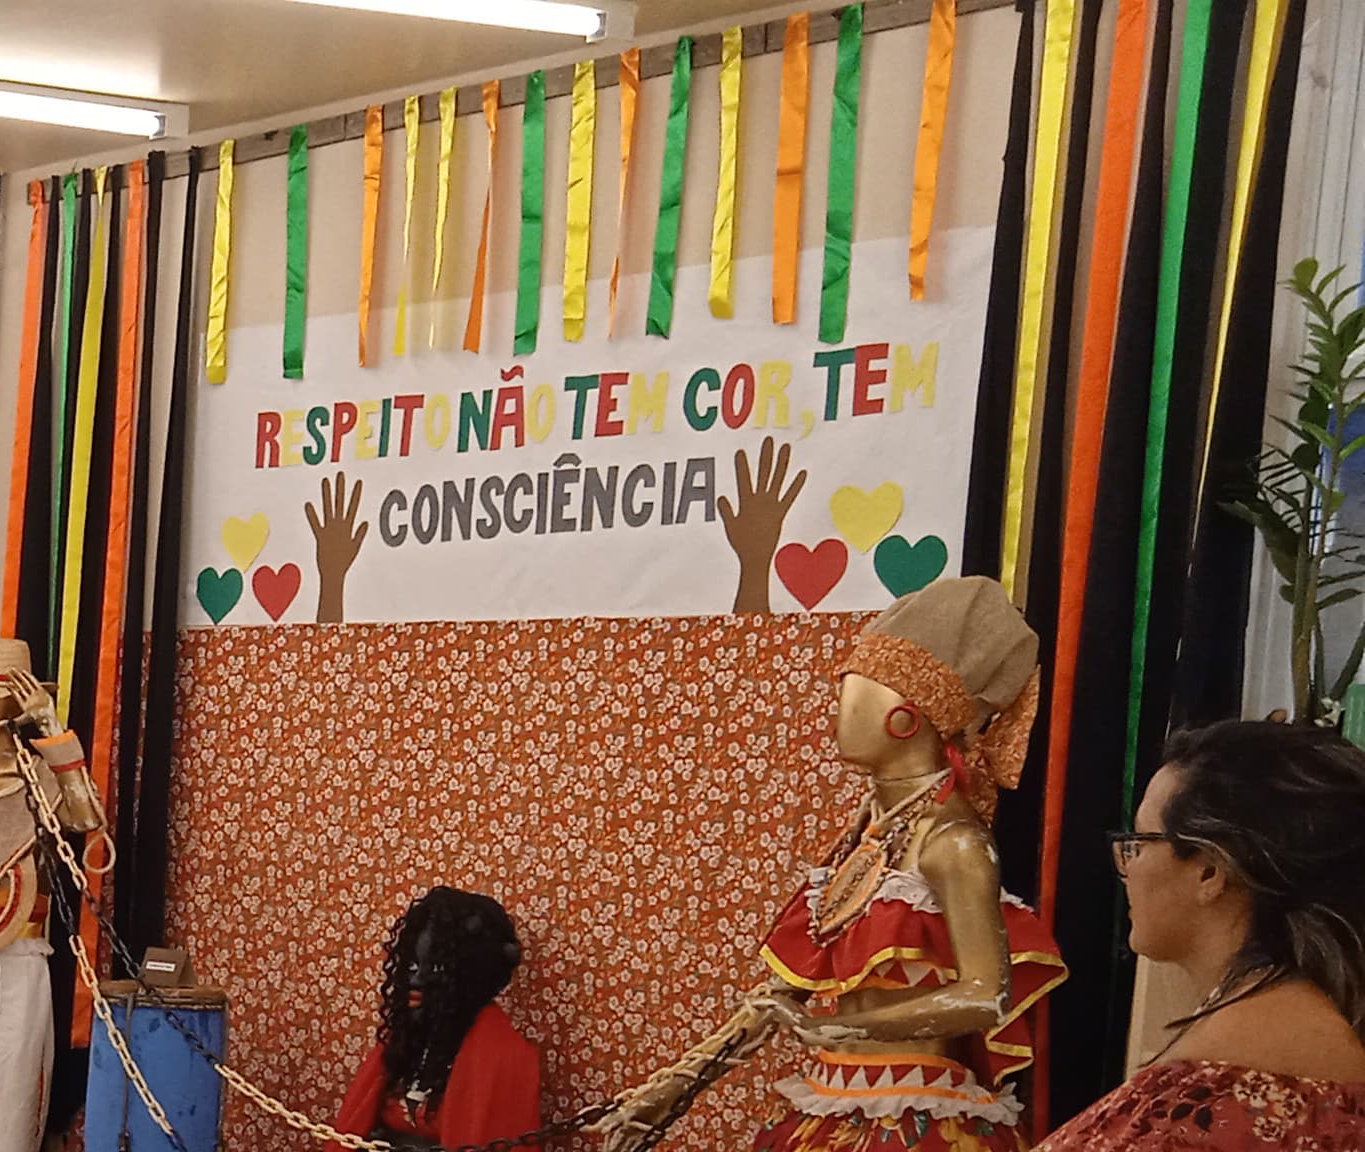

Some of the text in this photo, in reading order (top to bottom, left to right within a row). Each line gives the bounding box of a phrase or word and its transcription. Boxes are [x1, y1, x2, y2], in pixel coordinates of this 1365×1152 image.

[255, 341, 940, 469] RESPEITO NÃO TEM COR, TEM
[379, 452, 716, 548] CONSCIÊNCIA
